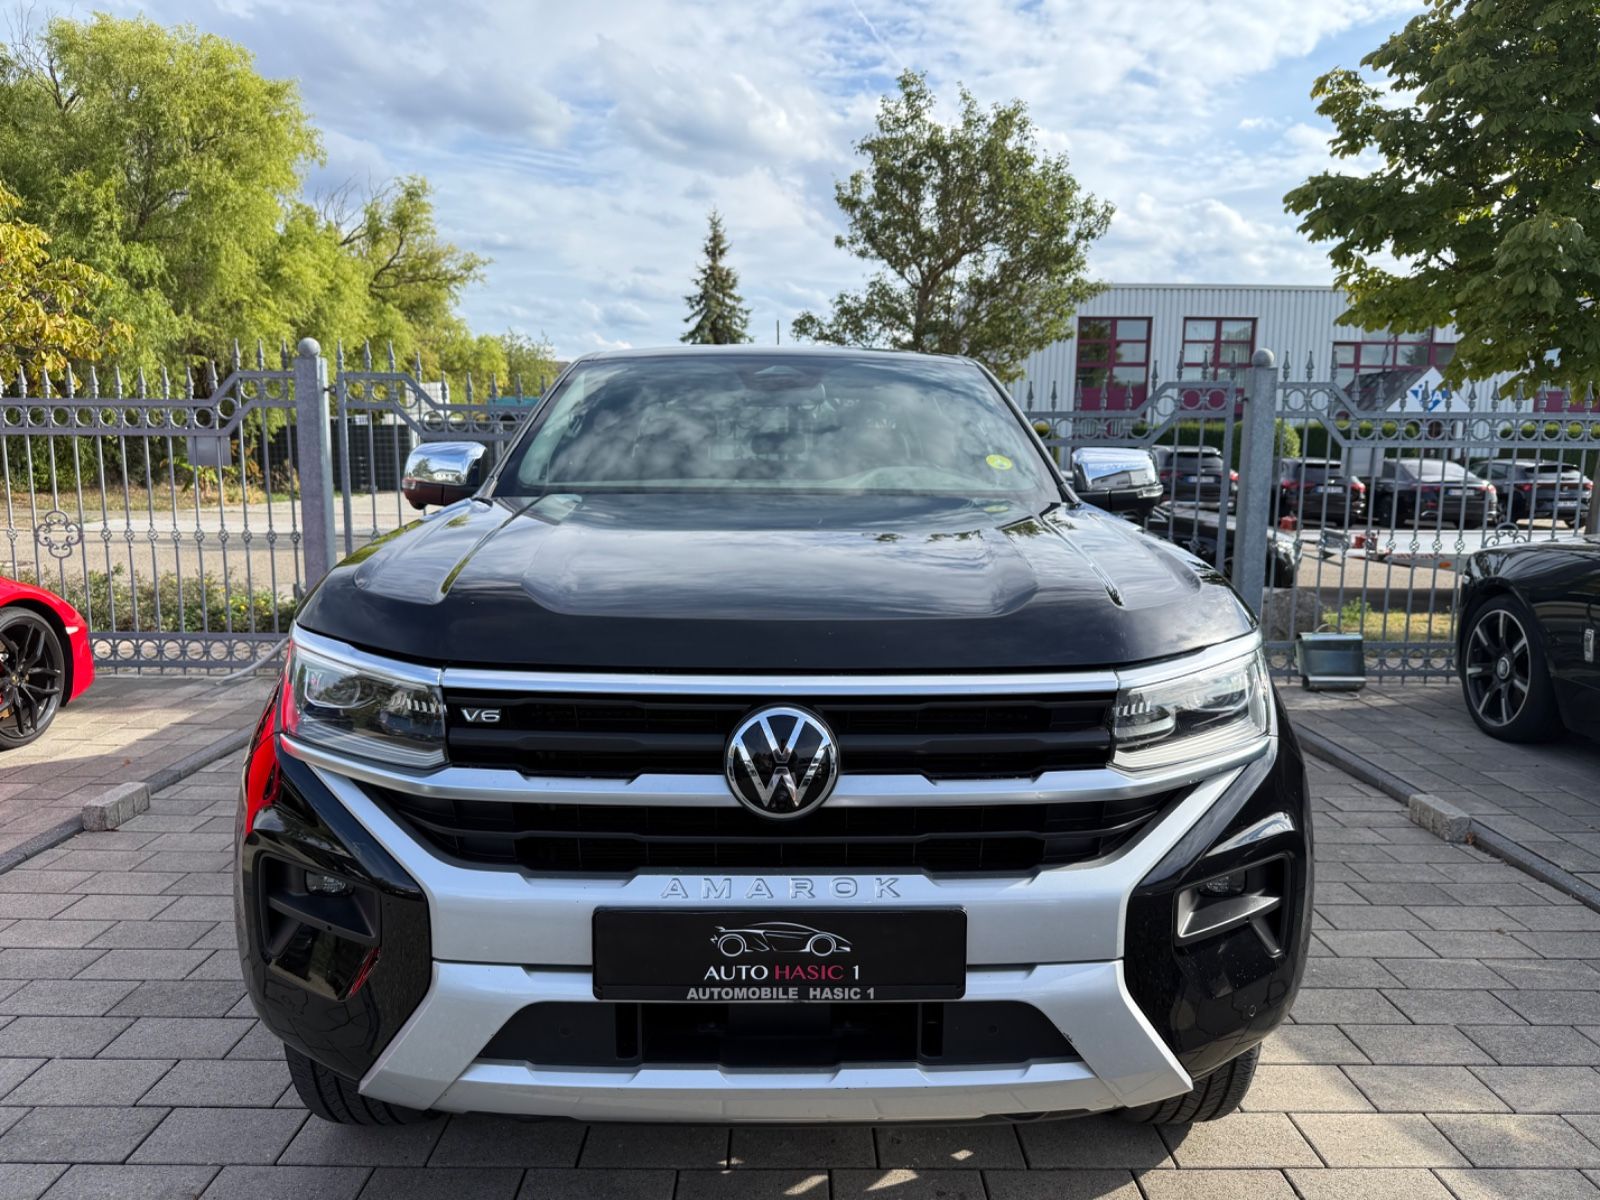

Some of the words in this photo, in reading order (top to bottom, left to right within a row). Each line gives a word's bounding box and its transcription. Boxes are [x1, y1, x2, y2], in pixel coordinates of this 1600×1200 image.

[460, 708, 500, 722] V6
[730, 708, 834, 812] VW
[660, 877, 901, 899] AMAROK
[704, 965, 769, 980] AUTO
[774, 965, 845, 980] HASIC
[852, 965, 859, 980] 1
[686, 987, 799, 1000] AUTOMOBILE
[809, 987, 862, 1000] HASIC
[866, 987, 875, 1000] 1
